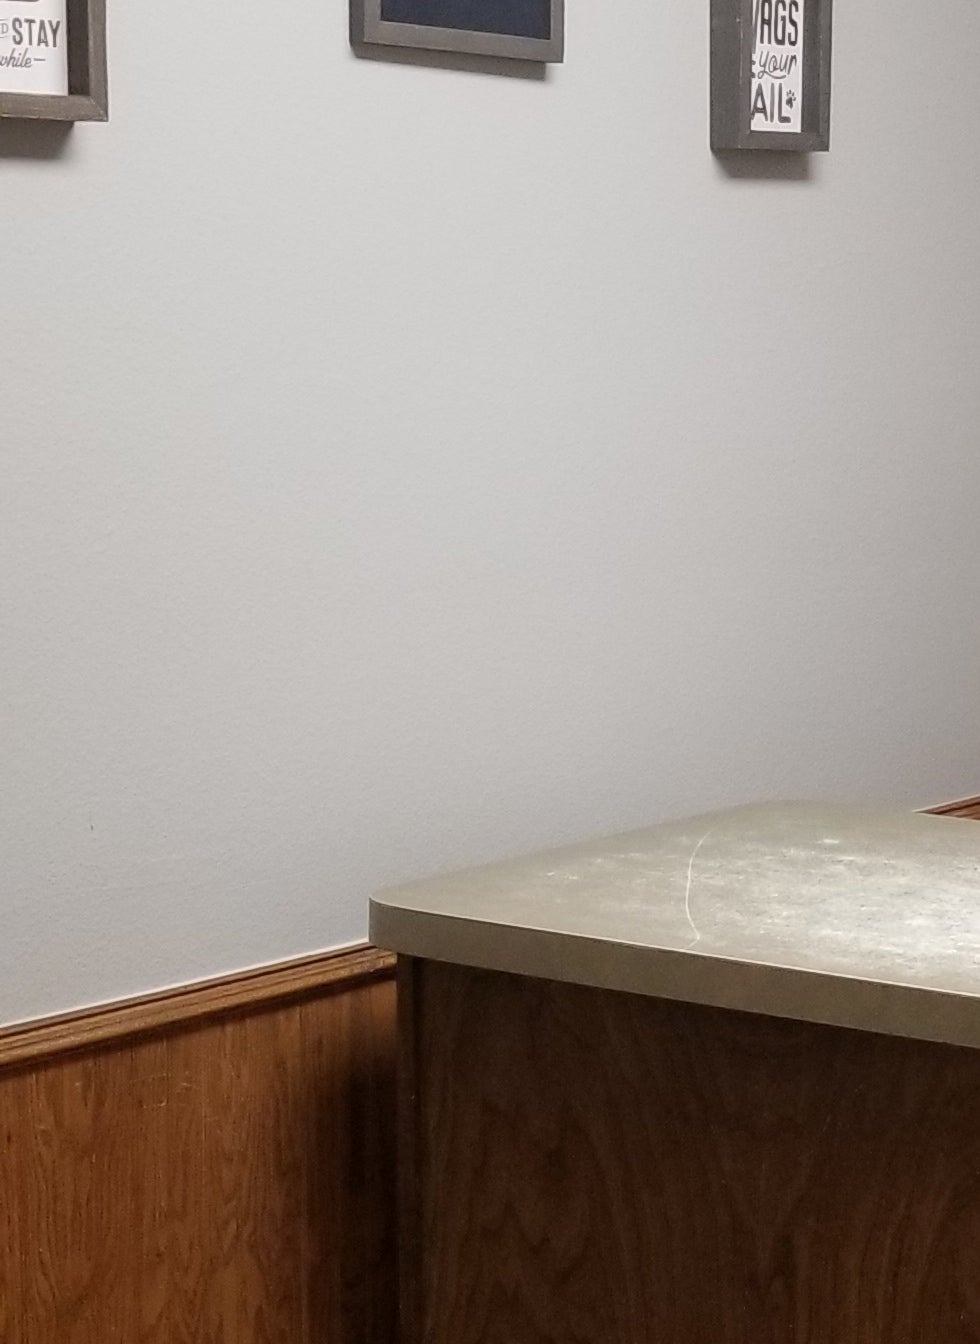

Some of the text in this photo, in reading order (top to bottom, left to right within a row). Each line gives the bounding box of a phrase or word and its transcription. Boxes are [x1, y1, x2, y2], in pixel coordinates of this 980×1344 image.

[11, 17, 61, 48] STAY
[757, 50, 798, 80] your
[751, 82, 792, 124] AIL
